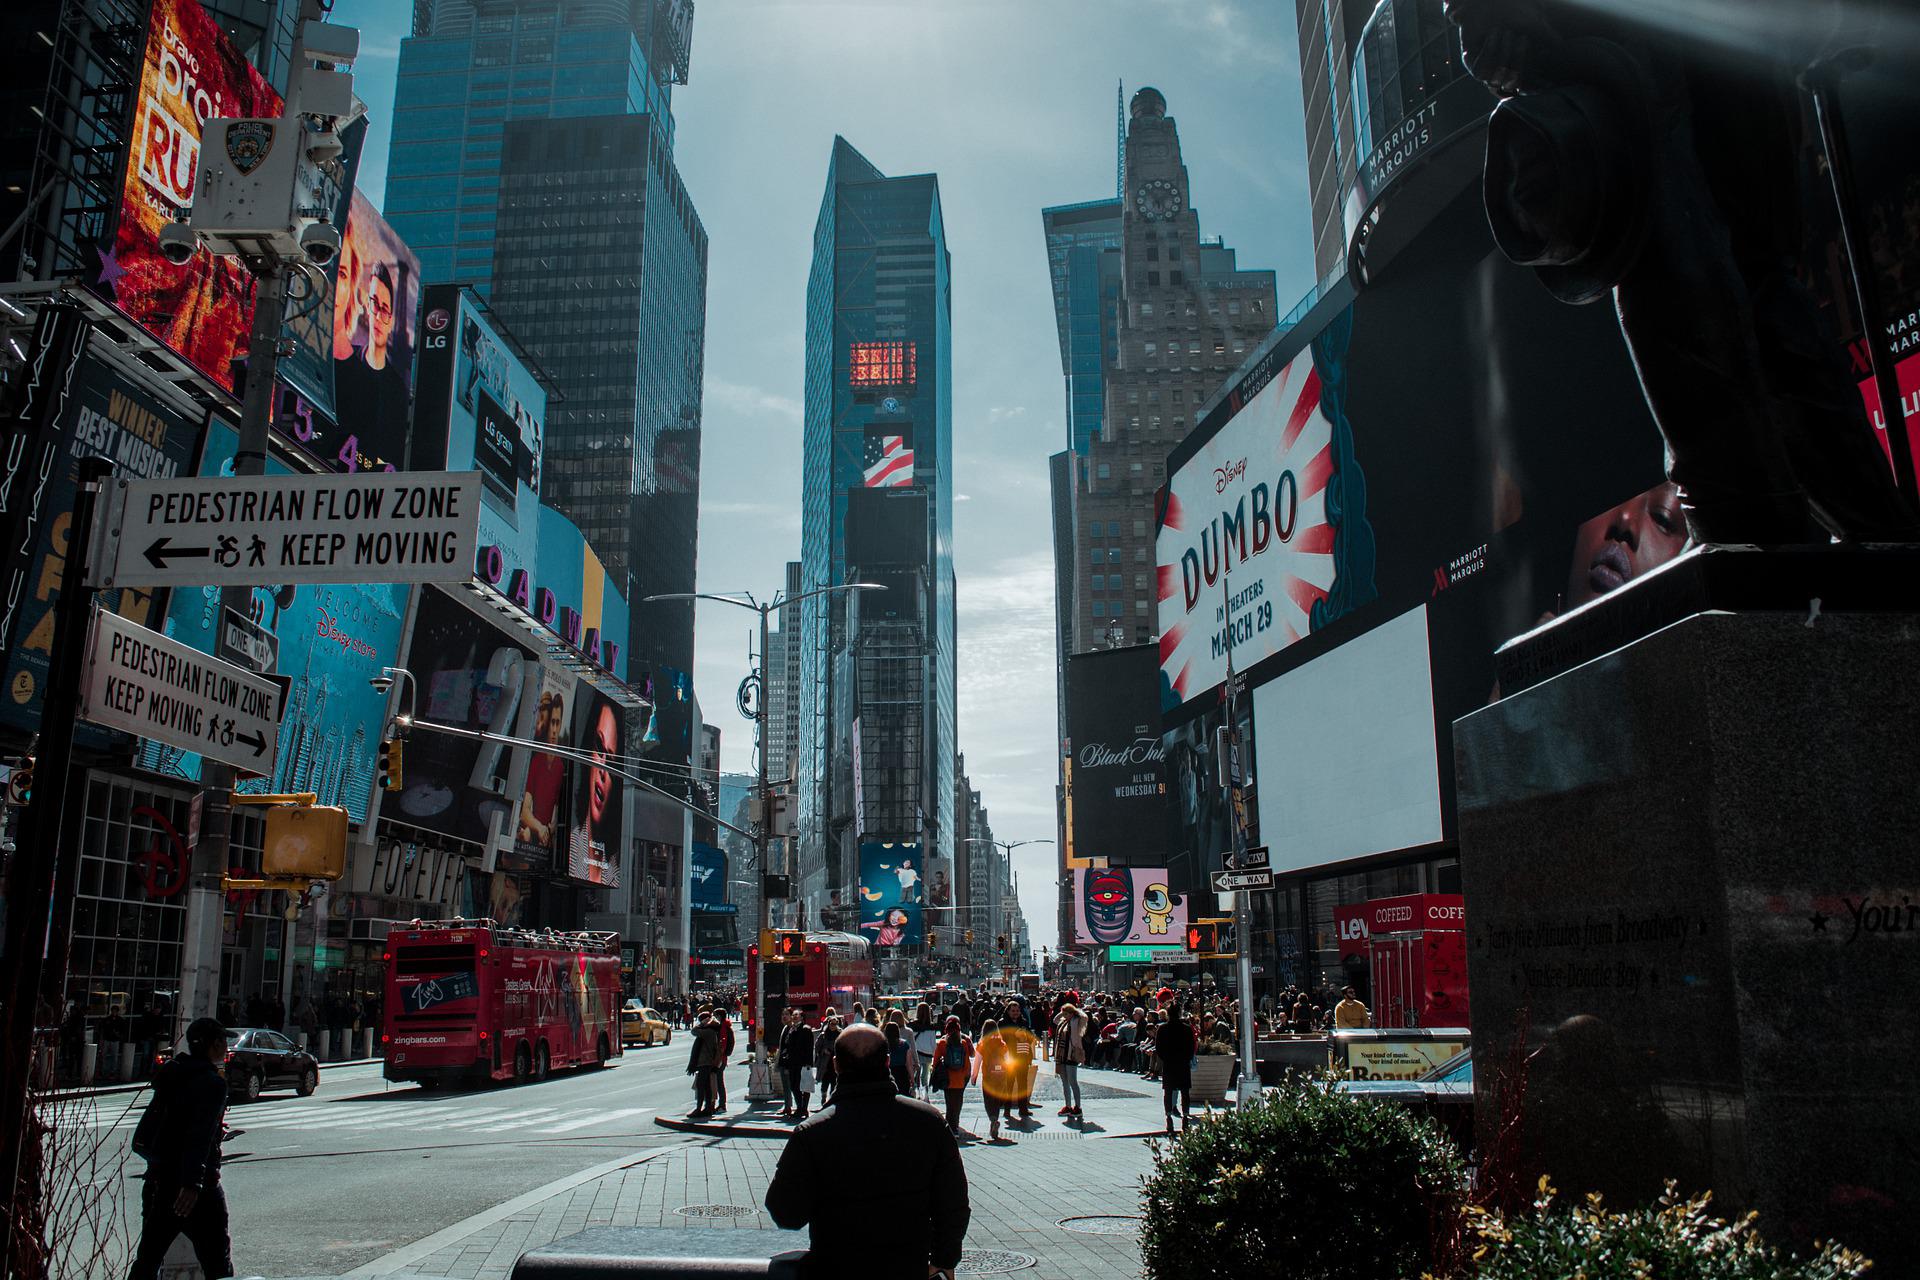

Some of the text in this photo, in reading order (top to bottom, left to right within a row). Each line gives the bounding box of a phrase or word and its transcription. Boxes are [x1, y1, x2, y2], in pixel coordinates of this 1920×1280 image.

[163, 16, 200, 74] bravo
[1368, 100, 1438, 172] MARRIOTT
[1370, 129, 1430, 191] MARQUIS
[425, 335, 447, 349] LG
[1242, 354, 1274, 391] MARRIOTT
[1243, 371, 1272, 405] MARQUIS
[108, 388, 168, 449] WINNER!
[1901, 389, 1920, 418] LI
[75, 405, 119, 455] BEST
[484, 416, 496, 435] LG
[495, 428, 513, 454] gram
[1212, 456, 1248, 495] Disney
[147, 486, 462, 524] PEDESTRIAN FLOW ZONE
[280, 534, 346, 566] KEEP
[355, 531, 457, 565] MOVING
[1181, 469, 1298, 614] DUMBO
[1450, 543, 1488, 571] MARRIOTT
[1450, 558, 1485, 583] MARQUIS
[478, 544, 620, 673] OADWAY
[1216, 578, 1264, 623] IN THEATERS
[230, 627, 270, 666] ONE WAY
[1211, 601, 1273, 660] MARCH 29
[110, 631, 273, 722] PEDESTRIAN FLOW ZONE
[104, 675, 203, 738] KEEP MOVING
[1080, 743, 1130, 768] Black
[1115, 783, 1156, 798] WEDNESDAY
[1221, 874, 1266, 886] ONE WAY
[1376, 905, 1413, 923] COFFEED
[1615, 912, 1690, 949] Broadway
[1120, 949, 1142, 958] LINE
[411, 980, 444, 1010] Zing
[1616, 962, 1642, 996] Boy
[394, 1036, 446, 1046] zingbars.com
